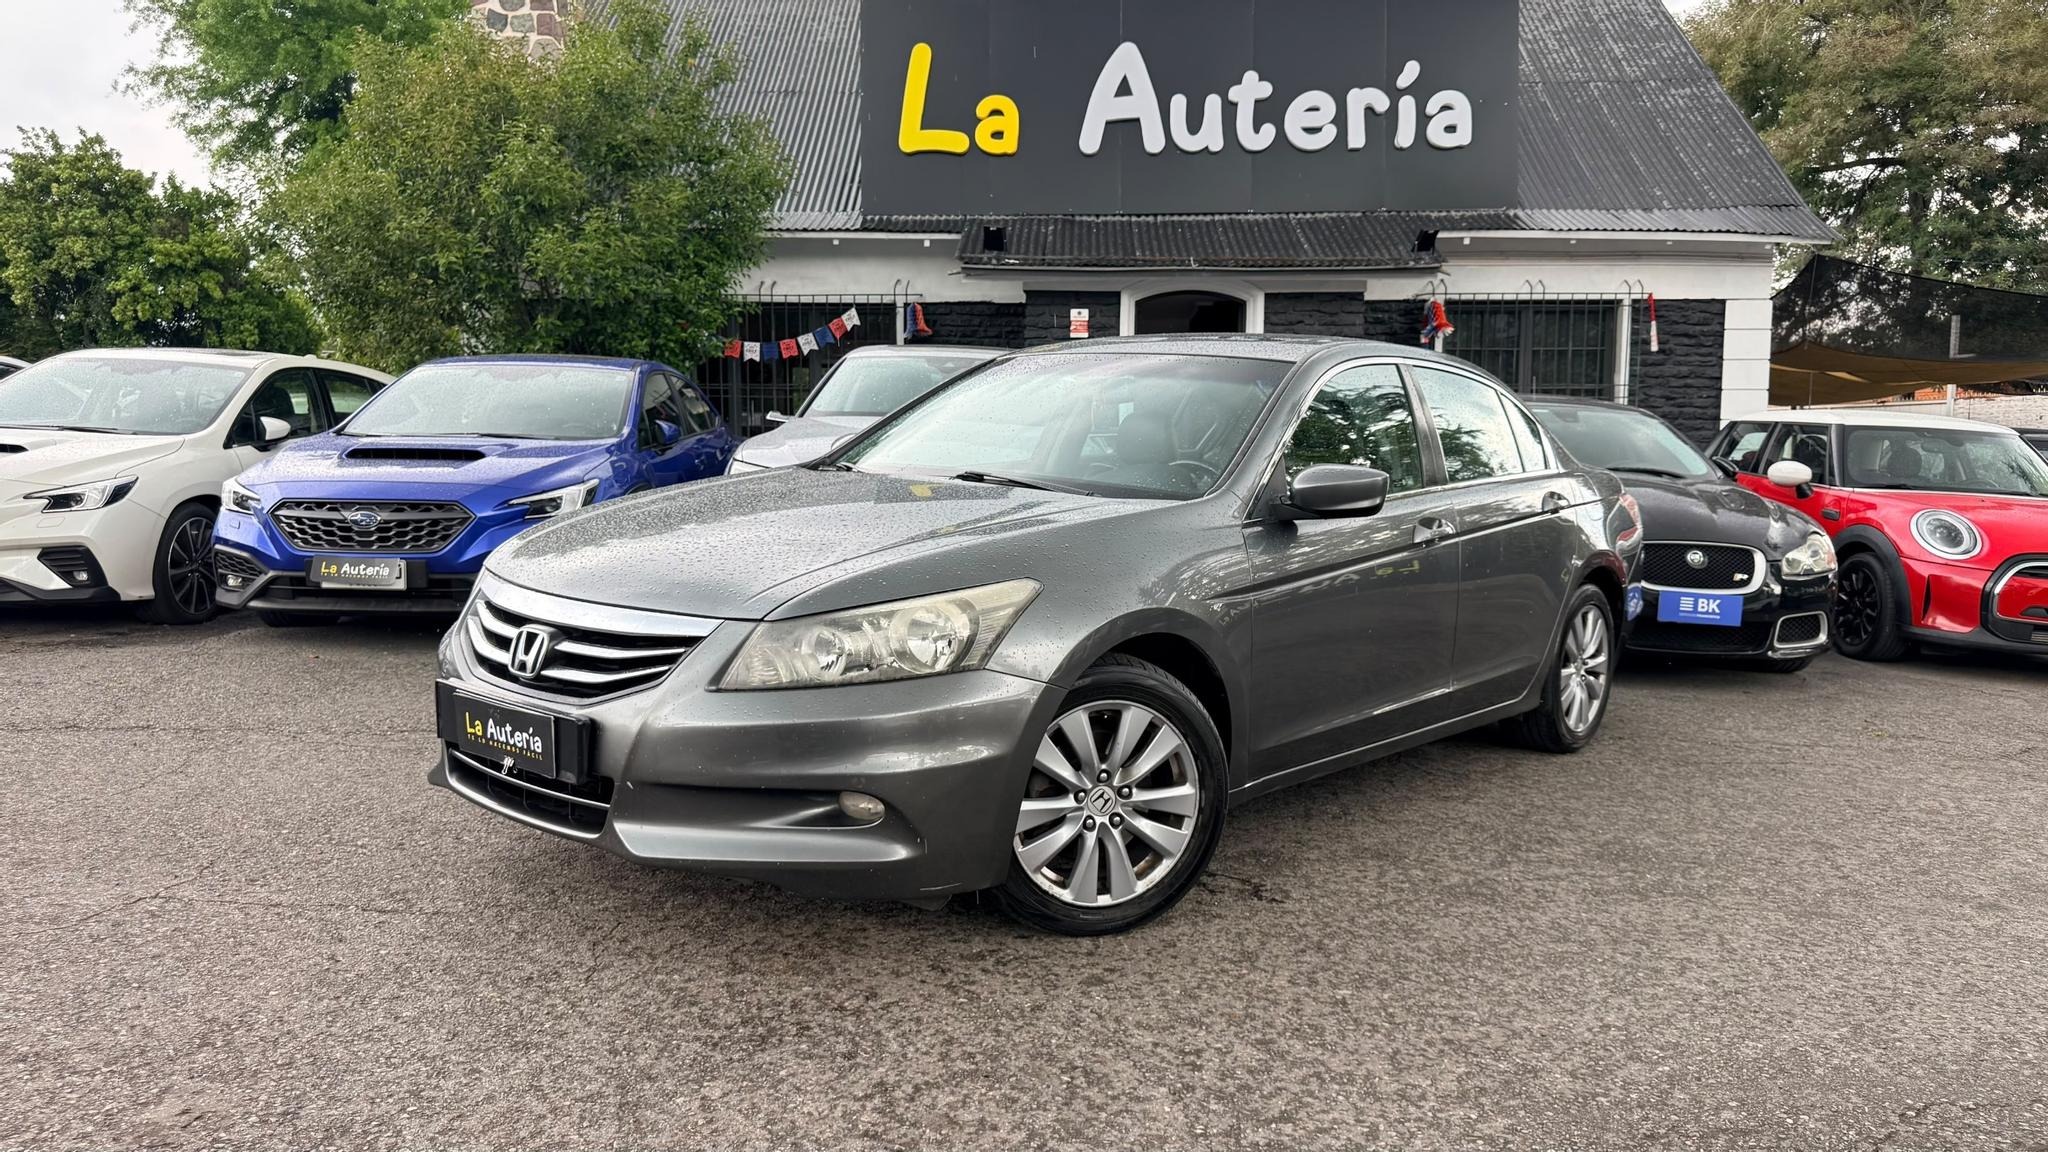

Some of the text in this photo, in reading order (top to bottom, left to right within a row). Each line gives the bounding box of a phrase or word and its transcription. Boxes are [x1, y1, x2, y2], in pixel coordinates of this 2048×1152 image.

[898, 41, 1473, 156] La Autería
[321, 561, 338, 574] La
[340, 562, 390, 576] Autería
[1697, 598, 1721, 614] BK
[465, 711, 543, 753] La Autería
